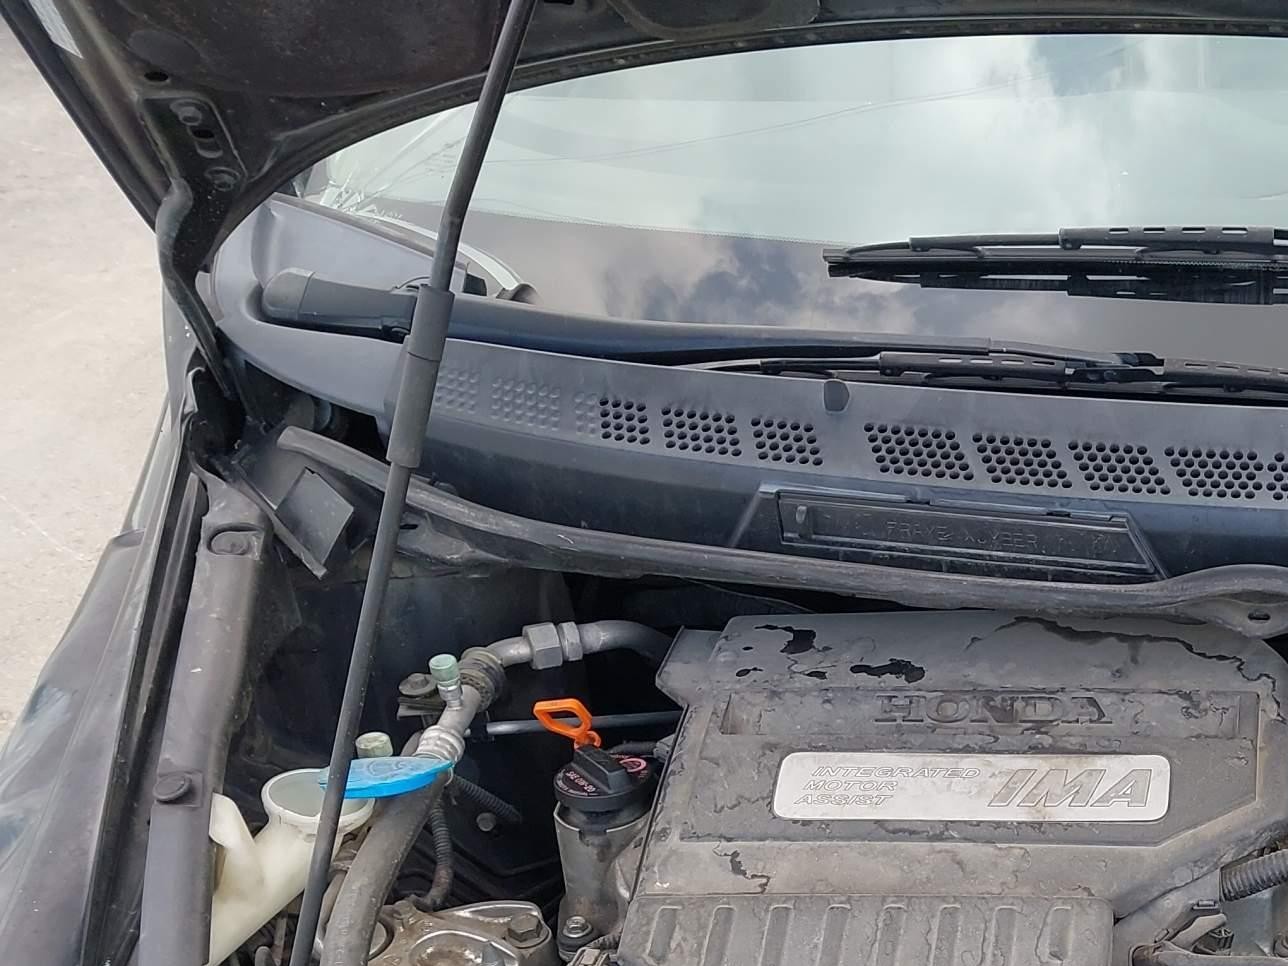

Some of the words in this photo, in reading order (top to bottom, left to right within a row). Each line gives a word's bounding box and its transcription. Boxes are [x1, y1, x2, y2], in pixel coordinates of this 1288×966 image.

[874, 695, 1113, 725] HONDA
[811, 766, 982, 778] INTEGRATED
[803, 780, 898, 791] MOTOR
[987, 768, 1153, 808] IMA
[794, 794, 893, 806] ASSIST
